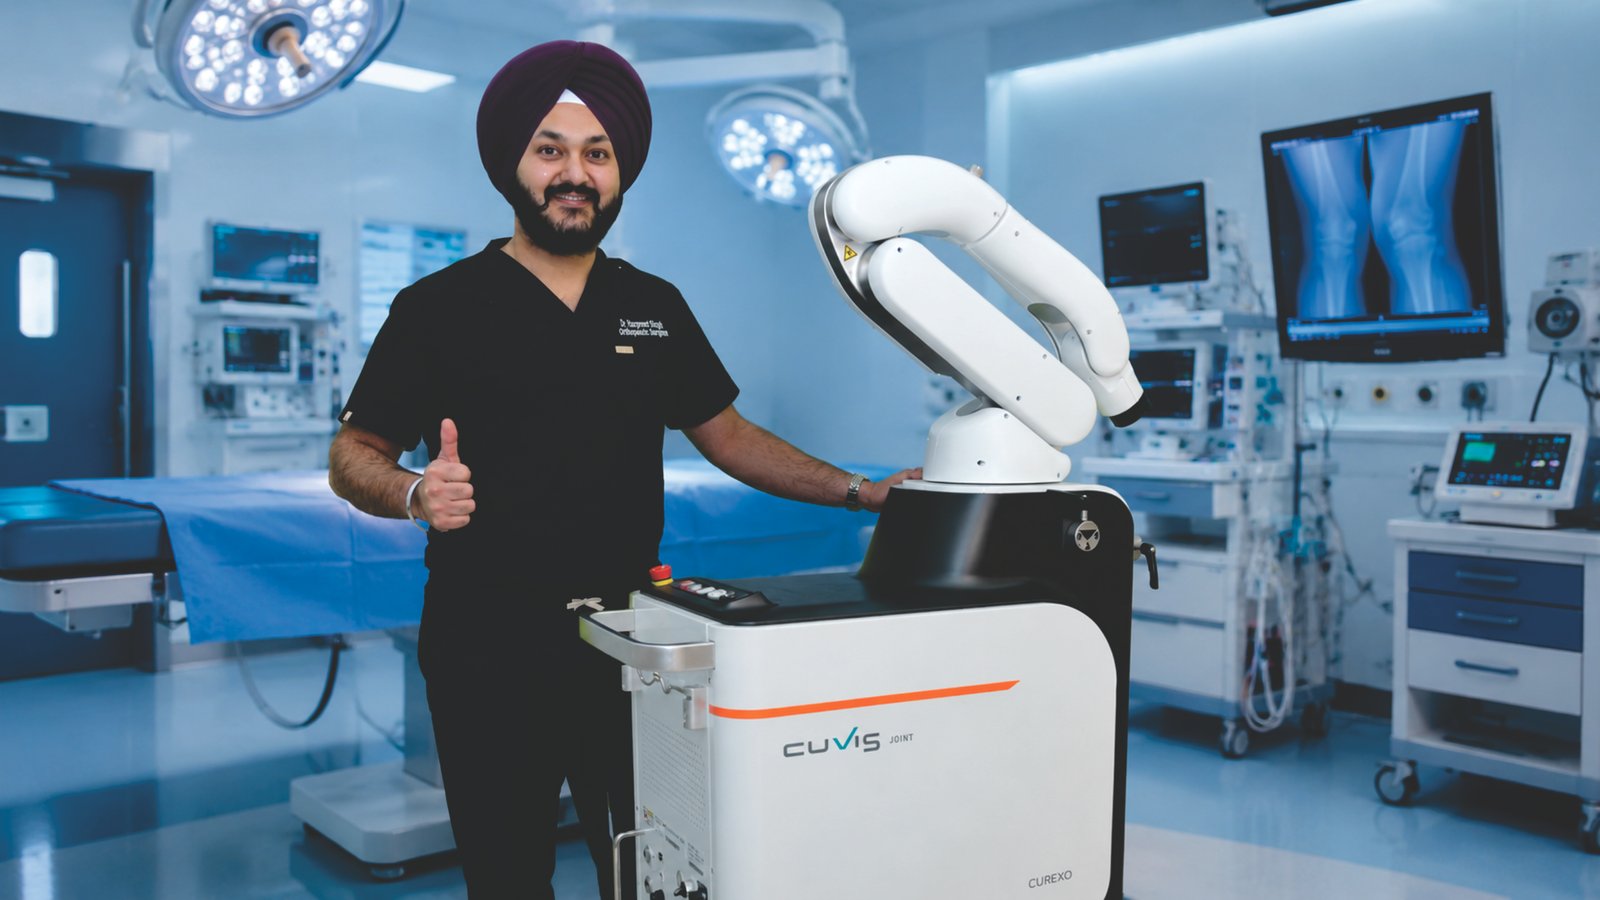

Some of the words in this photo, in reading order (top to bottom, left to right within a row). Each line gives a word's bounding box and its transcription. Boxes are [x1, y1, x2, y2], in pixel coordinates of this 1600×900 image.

[783, 726, 881, 758] CUVIS
[889, 733, 914, 744] JOINT
[1028, 869, 1073, 889] CUREXO
